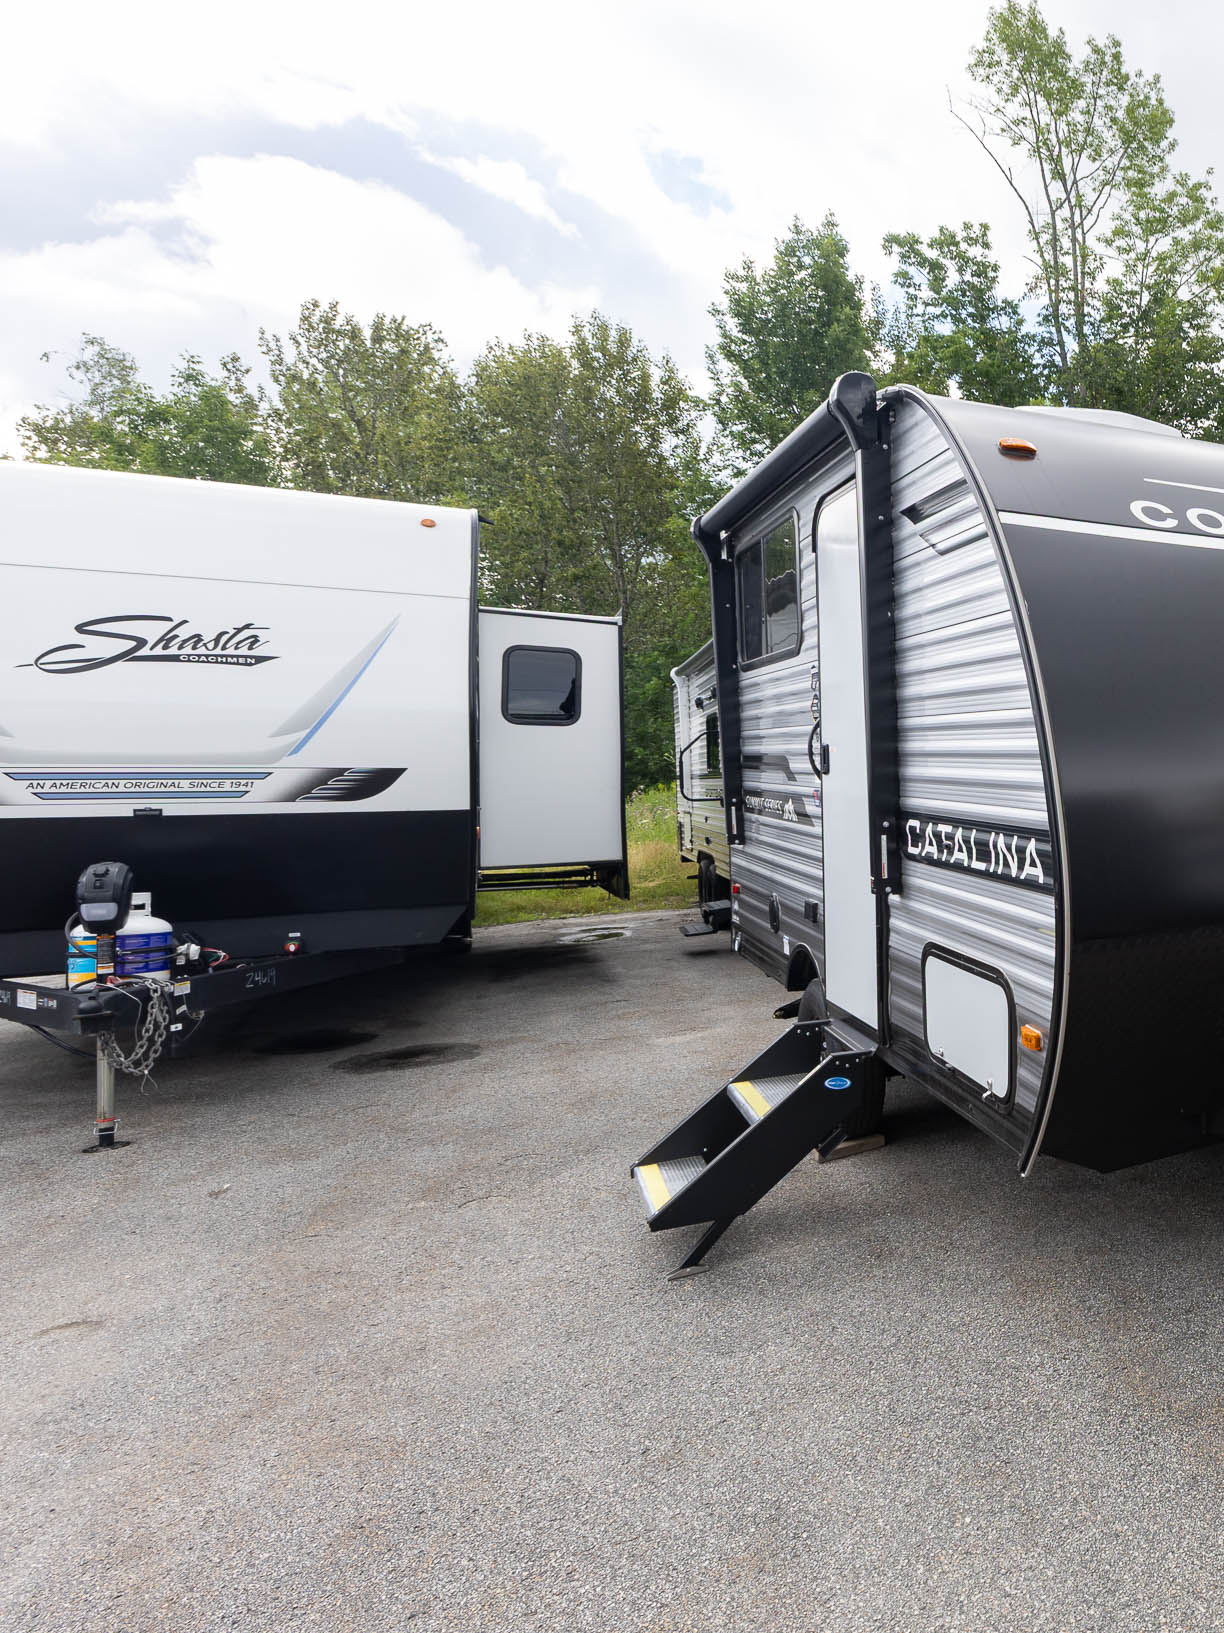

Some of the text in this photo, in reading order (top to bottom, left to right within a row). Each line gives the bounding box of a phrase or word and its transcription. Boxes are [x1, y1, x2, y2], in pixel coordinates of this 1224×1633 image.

[34, 614, 271, 675] Shasta
[179, 654, 257, 664] COACHMEN
[26, 781, 255, 790] AN AMERICAN ORIGINAL SINCE 1941
[906, 819, 1044, 884] CATALINA
